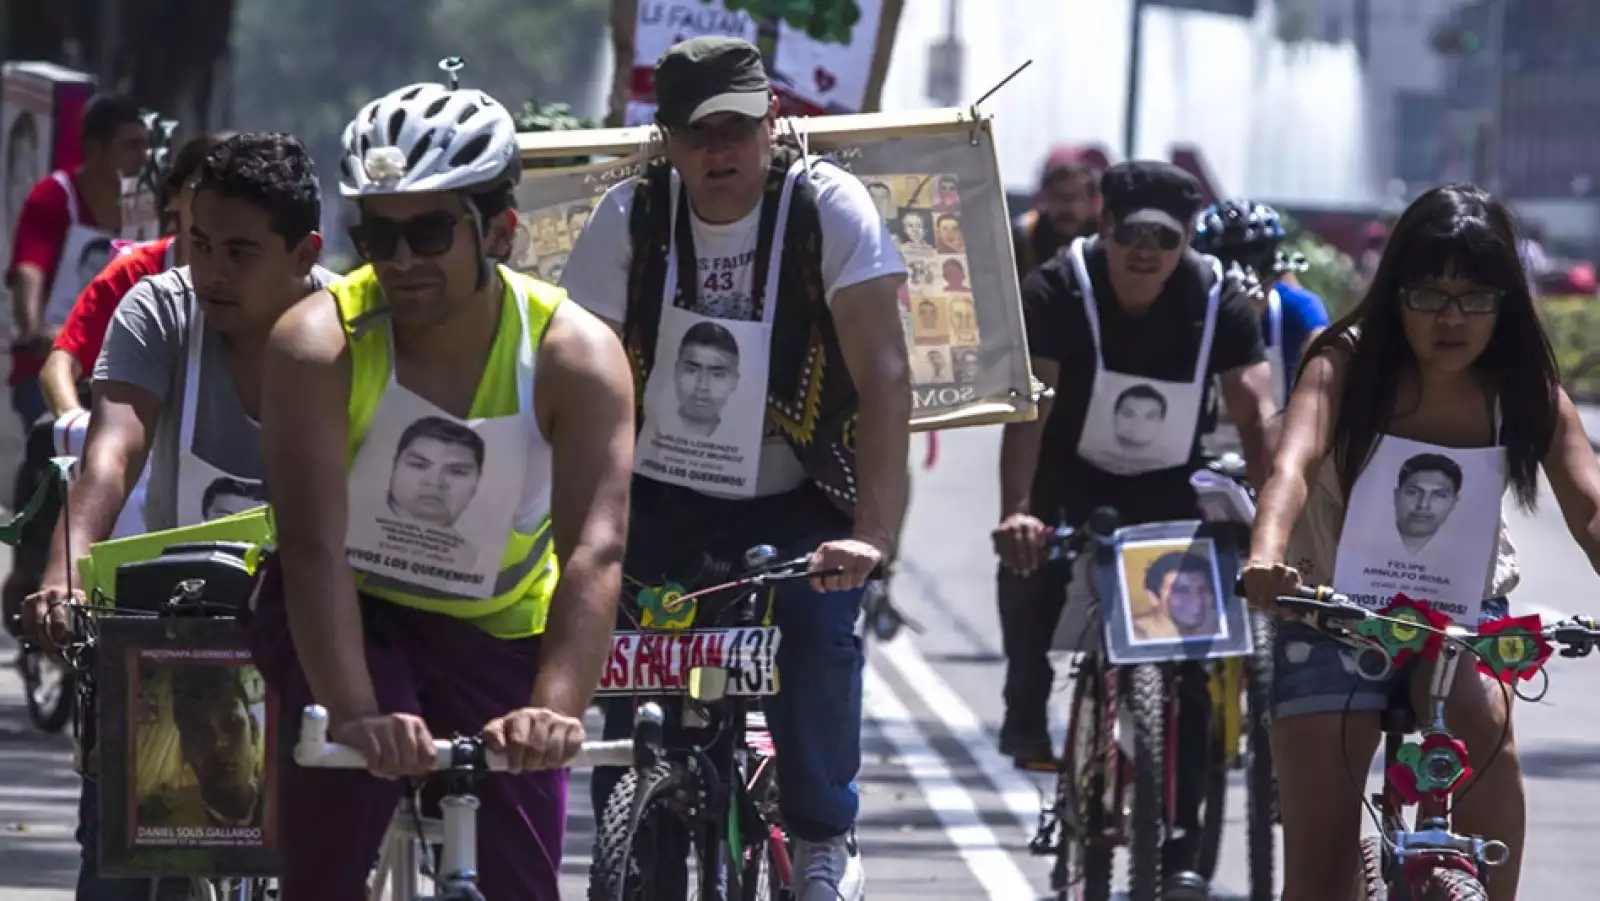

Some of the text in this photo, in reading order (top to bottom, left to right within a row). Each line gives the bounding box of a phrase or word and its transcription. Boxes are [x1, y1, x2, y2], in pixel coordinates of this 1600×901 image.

[667, 6, 747, 34] FALTAN
[704, 271, 733, 292] 43
[383, 555, 409, 570] LOS
[410, 561, 486, 586] QUEREMOS!
[1387, 559, 1426, 572] FELIPE
[1362, 567, 1451, 586] ARNULFO ROSA
[635, 633, 725, 688] FALTAN
[726, 629, 775, 692] 43!
[138, 826, 175, 838] DANIEL
[205, 826, 262, 839] GALLARDO
